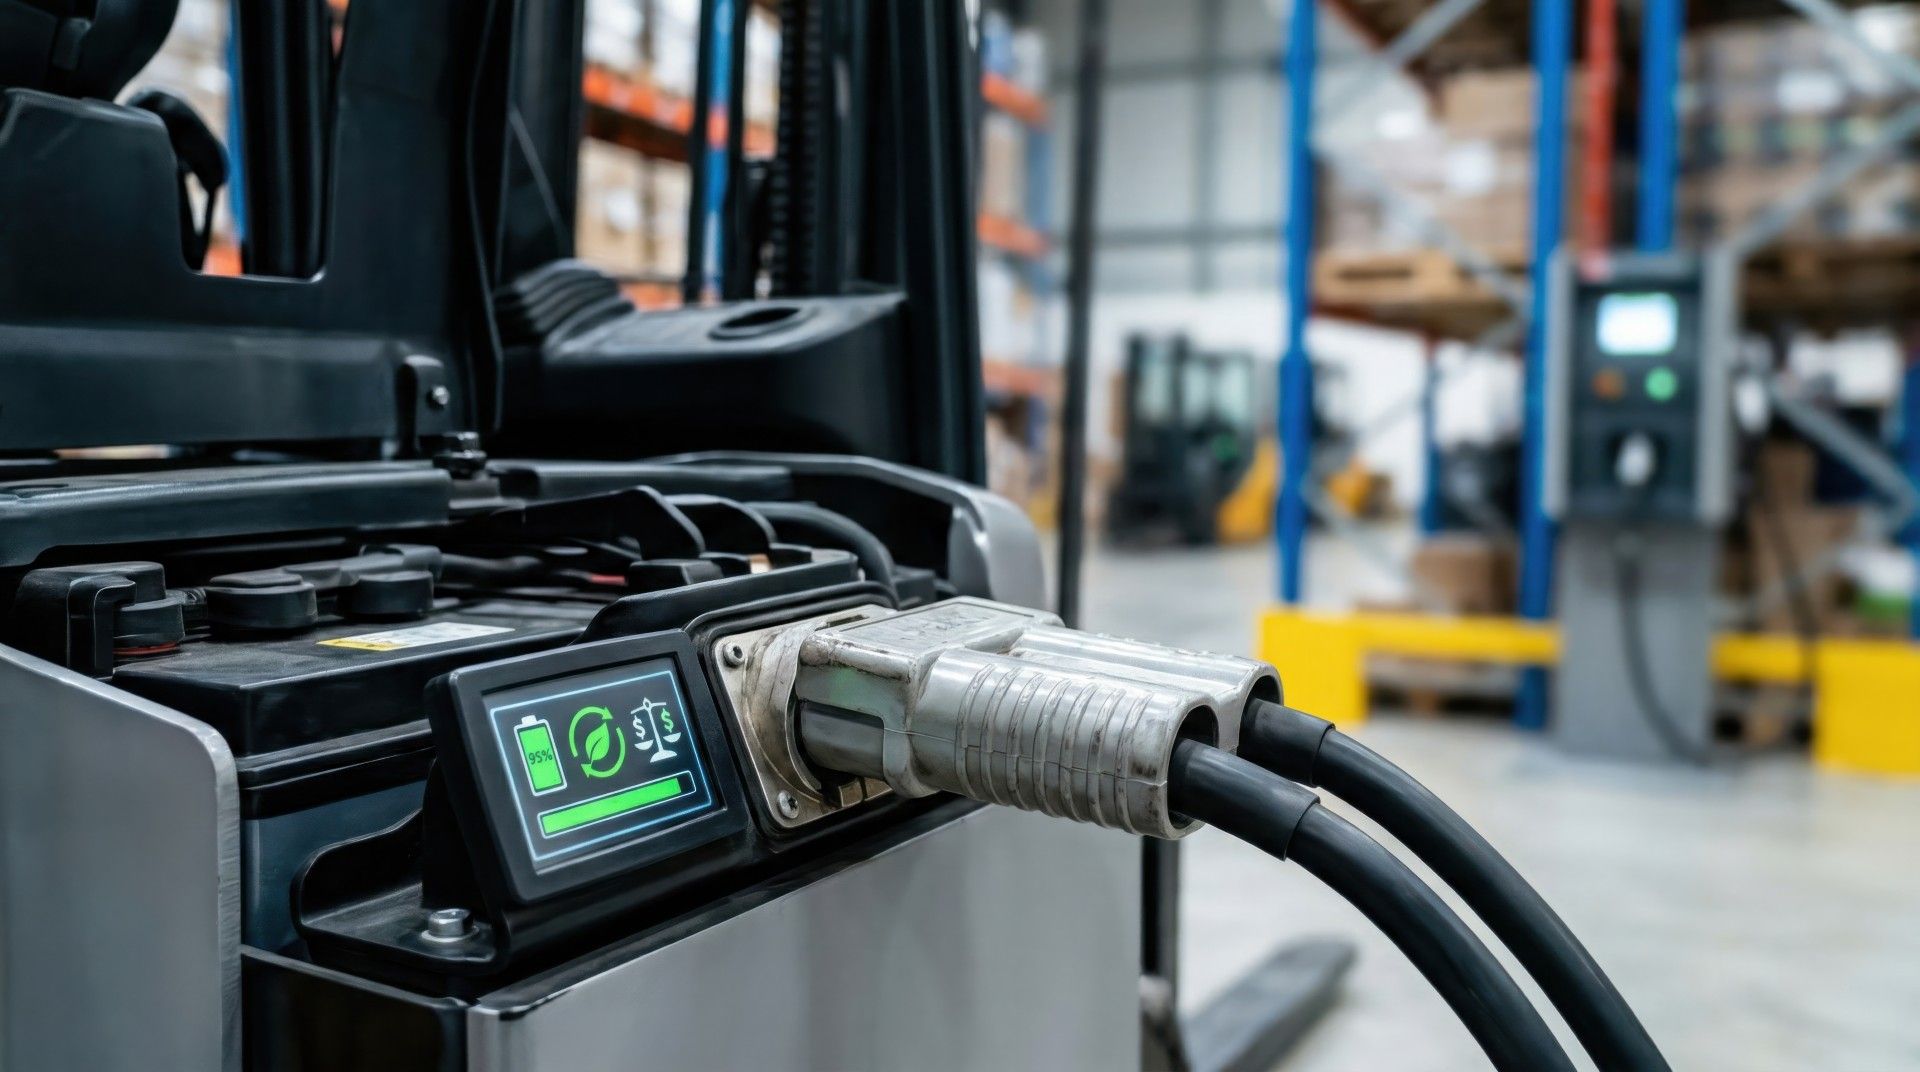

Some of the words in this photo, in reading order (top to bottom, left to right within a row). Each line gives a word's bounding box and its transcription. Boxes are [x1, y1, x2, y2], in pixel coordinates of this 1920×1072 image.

[632, 715, 646, 740] $
[660, 708, 674, 733] $
[528, 748, 553, 765] 95%
